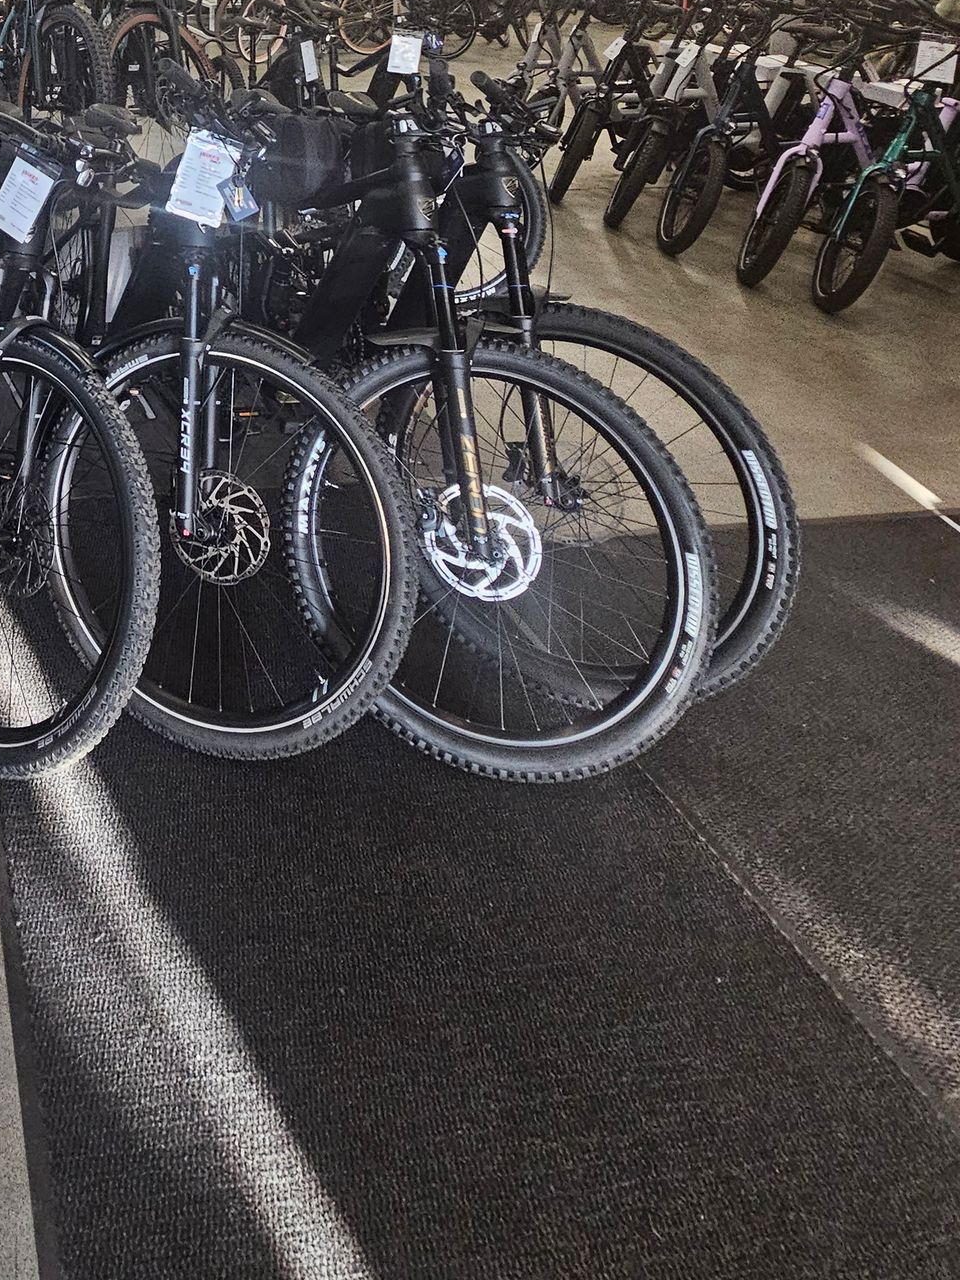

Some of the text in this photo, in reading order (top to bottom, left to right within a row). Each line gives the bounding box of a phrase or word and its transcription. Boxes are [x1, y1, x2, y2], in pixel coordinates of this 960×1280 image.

[179, 408, 192, 475] XCR34
[297, 433, 327, 536] MAXXIS
[37, 684, 98, 750] SCHWALBE
[302, 658, 373, 730] SCHWALBE
